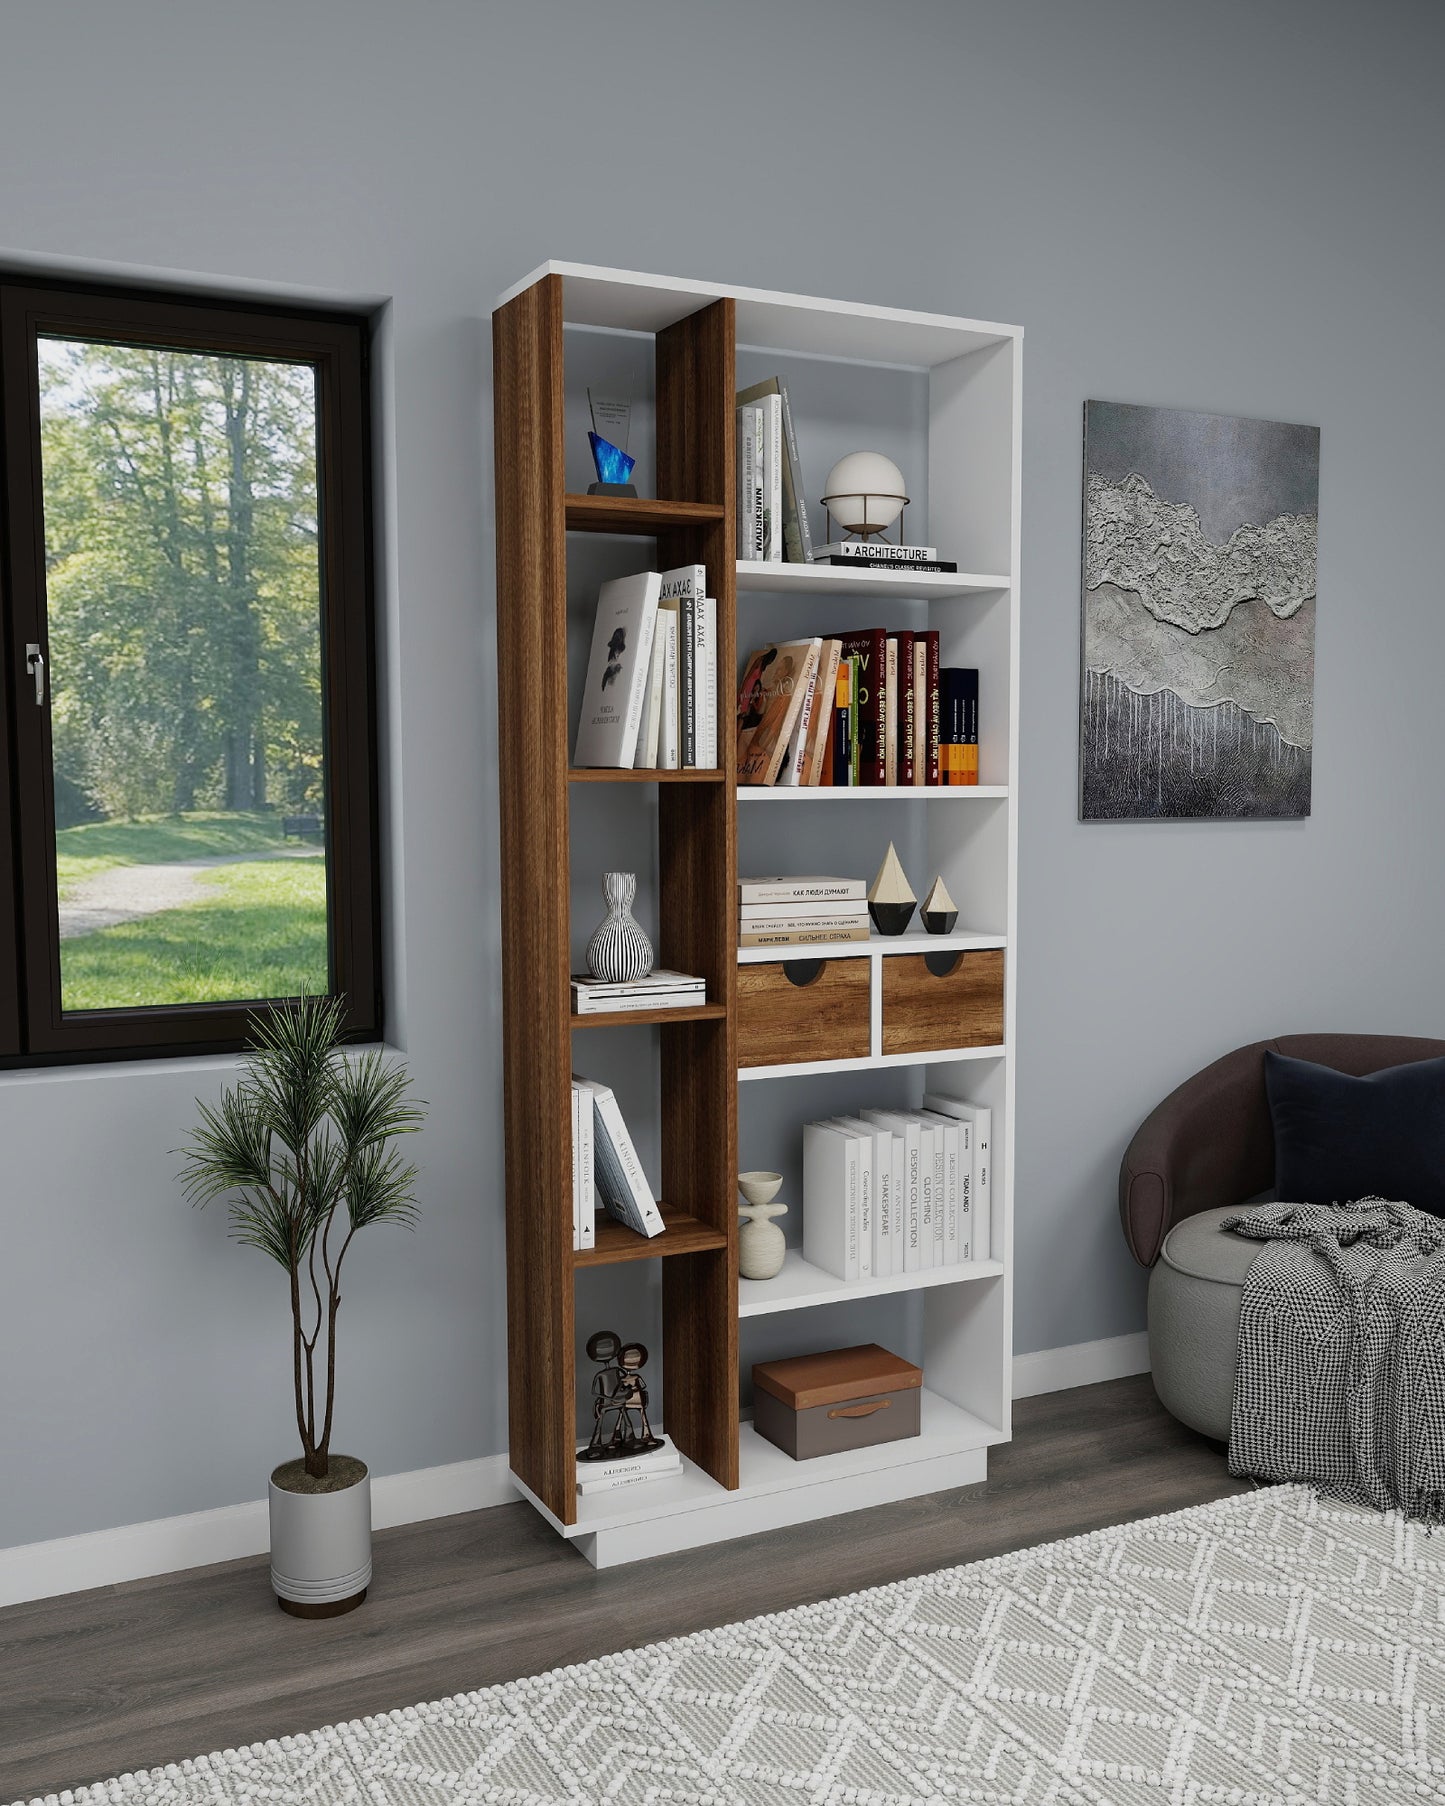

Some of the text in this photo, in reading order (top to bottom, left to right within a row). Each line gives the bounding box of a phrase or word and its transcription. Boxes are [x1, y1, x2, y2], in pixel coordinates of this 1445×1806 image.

[854, 545, 928, 561] ARCHITECTURE
[805, 889, 824, 897] ЛЮДИ
[824, 888, 849, 896] ДУМАЮТ
[798, 934, 827, 942] СИЛЬНЕЕ
[619, 1140, 638, 1178] KINFOLK
[895, 1179, 901, 1191] MY
[910, 1149, 918, 1248] DESIGN COLLECTION
[923, 1177, 931, 1224] CLOTHING
[935, 1152, 944, 1241] DESIGN COLLECTION
[881, 1174, 889, 1236] SHAKESPEARE
